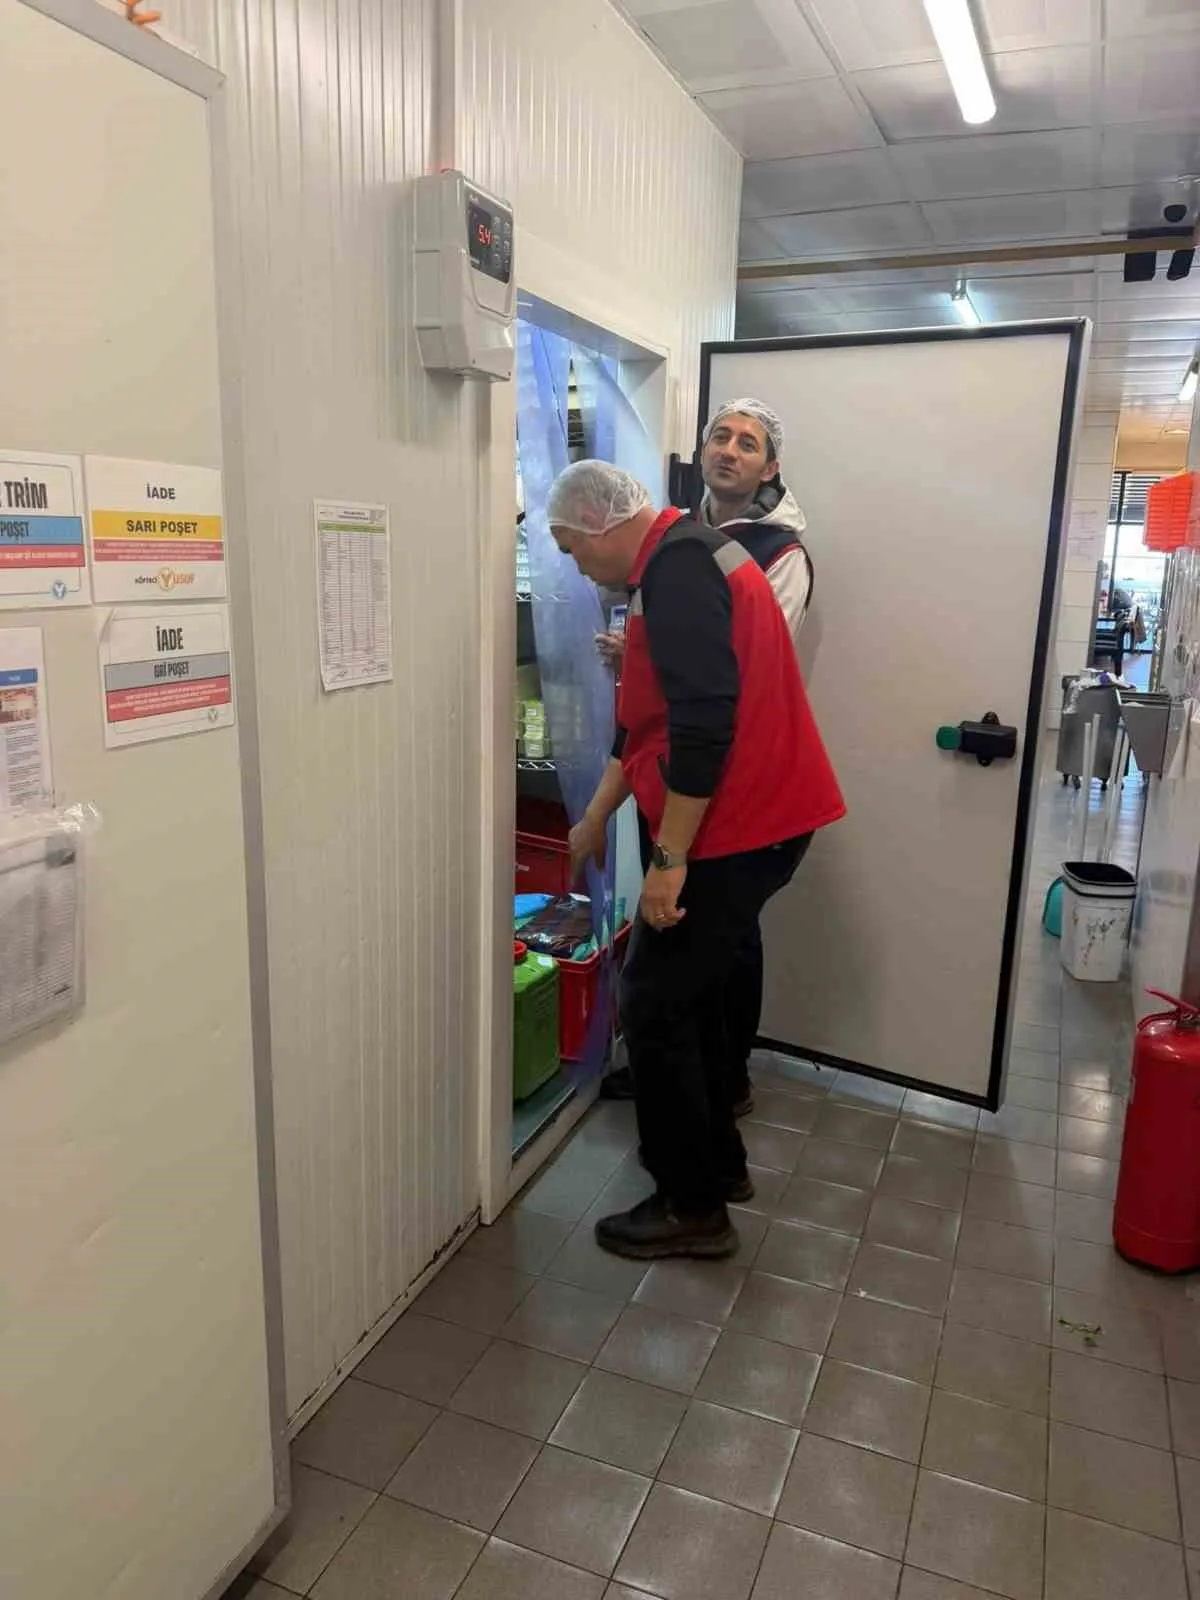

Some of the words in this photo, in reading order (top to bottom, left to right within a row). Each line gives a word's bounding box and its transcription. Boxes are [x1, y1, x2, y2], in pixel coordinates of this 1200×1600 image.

[4, 477, 48, 509] TRİM
[146, 482, 176, 500] İADE
[126, 519, 156, 533] SARI
[160, 521, 198, 536] POŞET
[156, 625, 184, 651] İADE
[167, 661, 189, 678] POŞET
